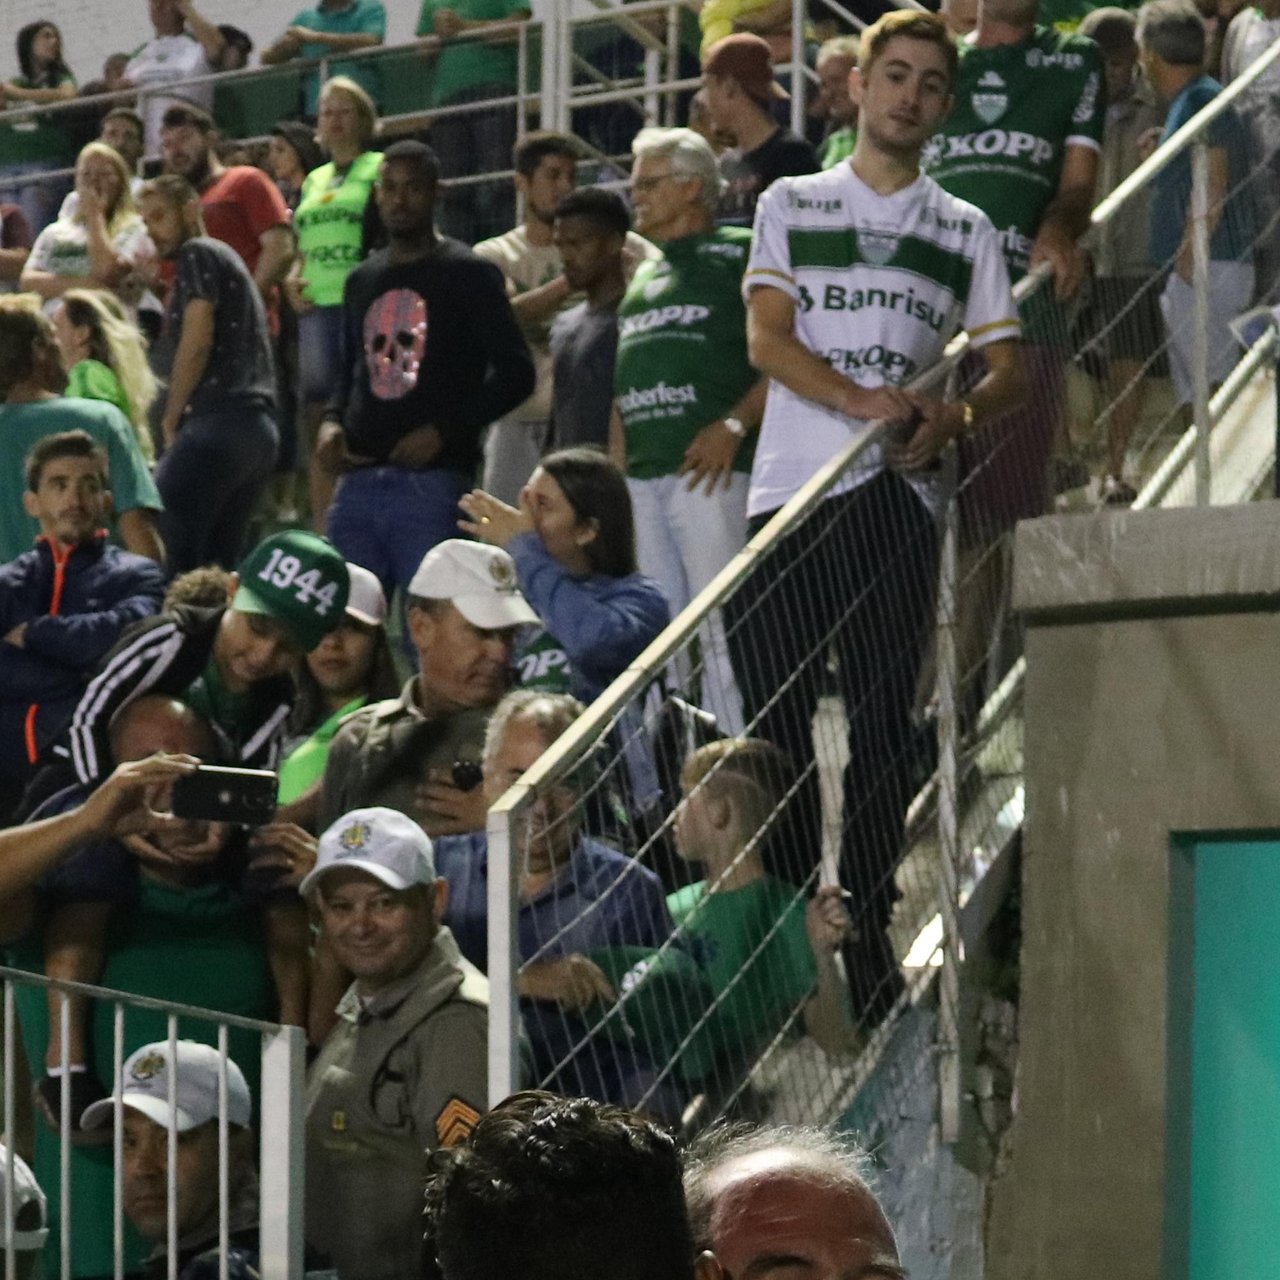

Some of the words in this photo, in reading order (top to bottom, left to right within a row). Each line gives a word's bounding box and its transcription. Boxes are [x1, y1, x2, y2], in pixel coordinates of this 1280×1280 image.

[943, 128, 1054, 165] KOPP
[824, 284, 948, 330] Banrisu
[257, 547, 339, 617] 1944
